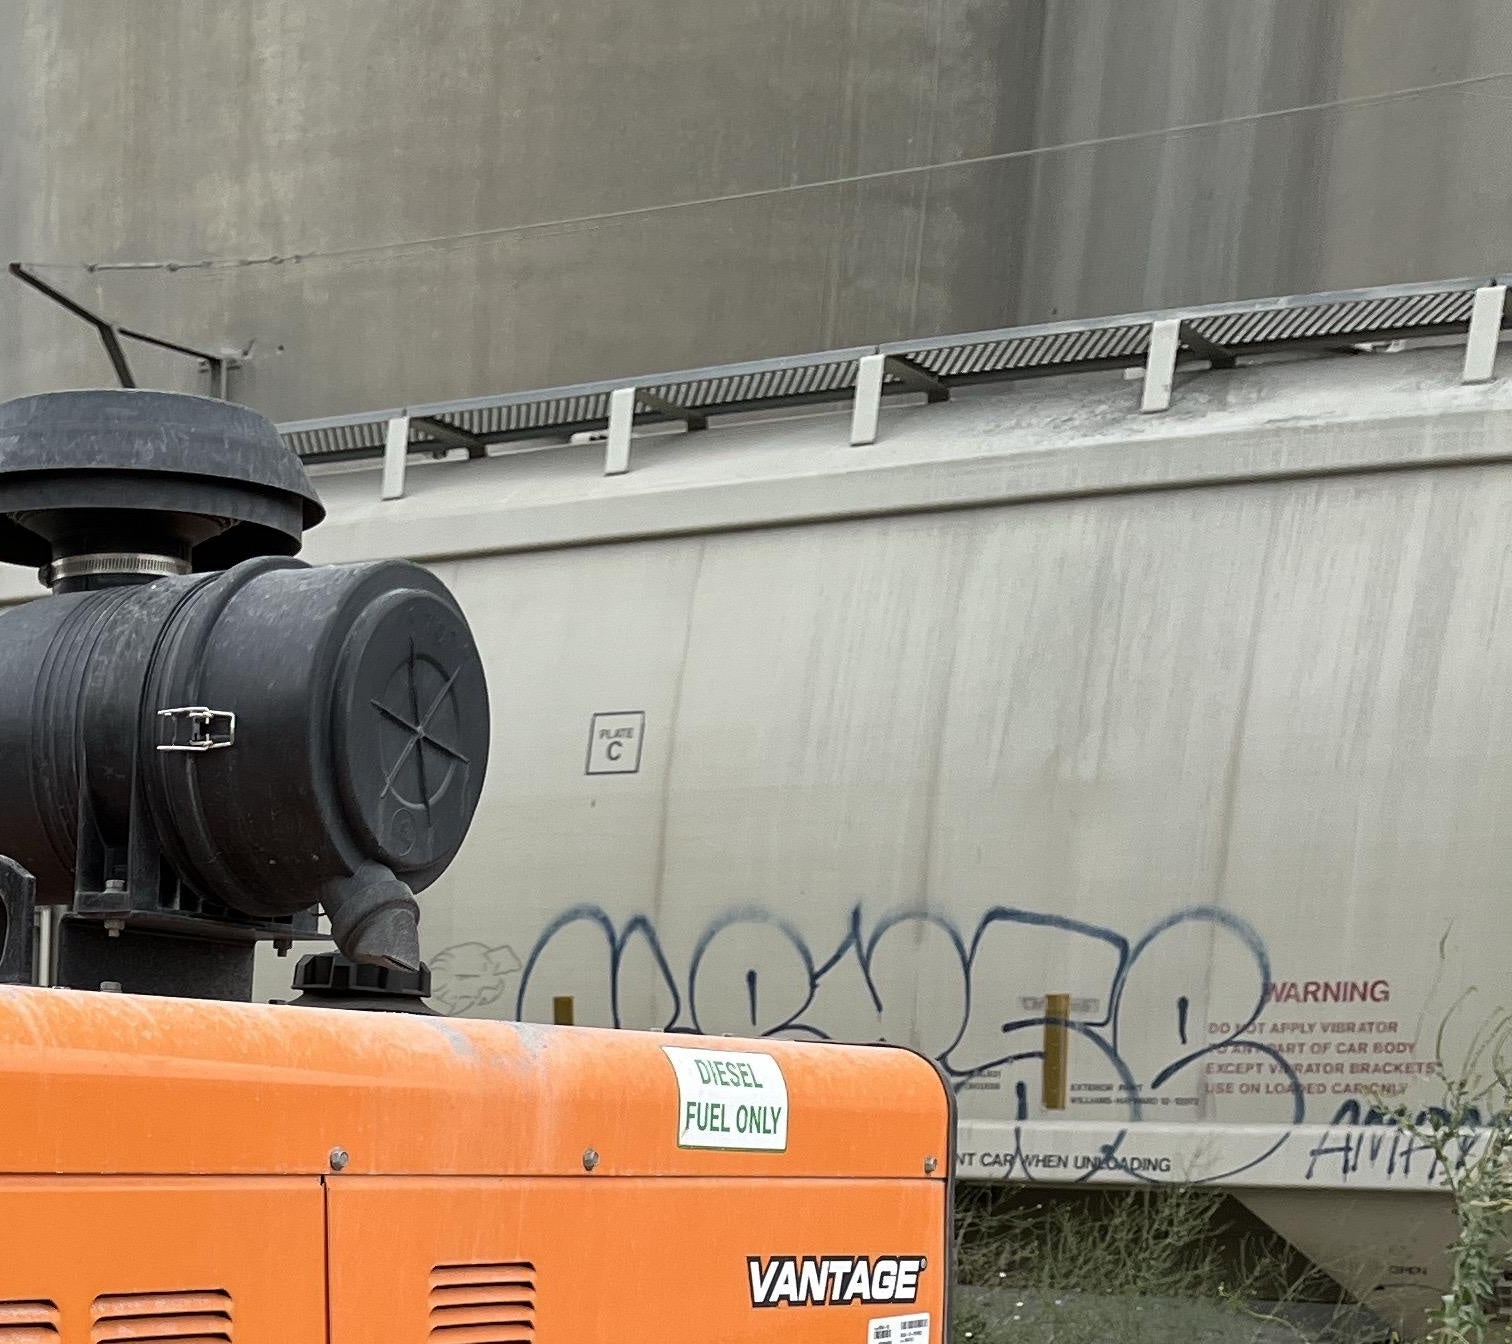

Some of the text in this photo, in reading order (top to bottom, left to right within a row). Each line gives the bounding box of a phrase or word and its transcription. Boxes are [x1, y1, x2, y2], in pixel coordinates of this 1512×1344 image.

[598, 727, 634, 739] PLATE
[606, 740, 623, 761] C
[1267, 980, 1390, 1002] WARNING
[1208, 1022, 1230, 1034] DO
[1270, 1022, 1317, 1034] APPLY
[1320, 1021, 1399, 1034] VIBRATOR
[1310, 1042, 1331, 1055] OF
[1334, 1042, 1369, 1055] CAR
[1373, 1042, 1417, 1055] BODY
[694, 1057, 764, 1089] DIESEL
[1206, 1061, 1436, 1075] EXCEPT VRATOR BRACKETS
[1239, 1082, 1261, 1095] ON
[1265, 1082, 1327, 1095] LOAED
[686, 1101, 781, 1135] FUEL ONLY
[979, 1153, 1015, 1168] CAR
[1020, 1154, 1070, 1169] WHEN
[1074, 1156, 1171, 1172] UNLOADING
[746, 1256, 922, 1307] VANTAGE
